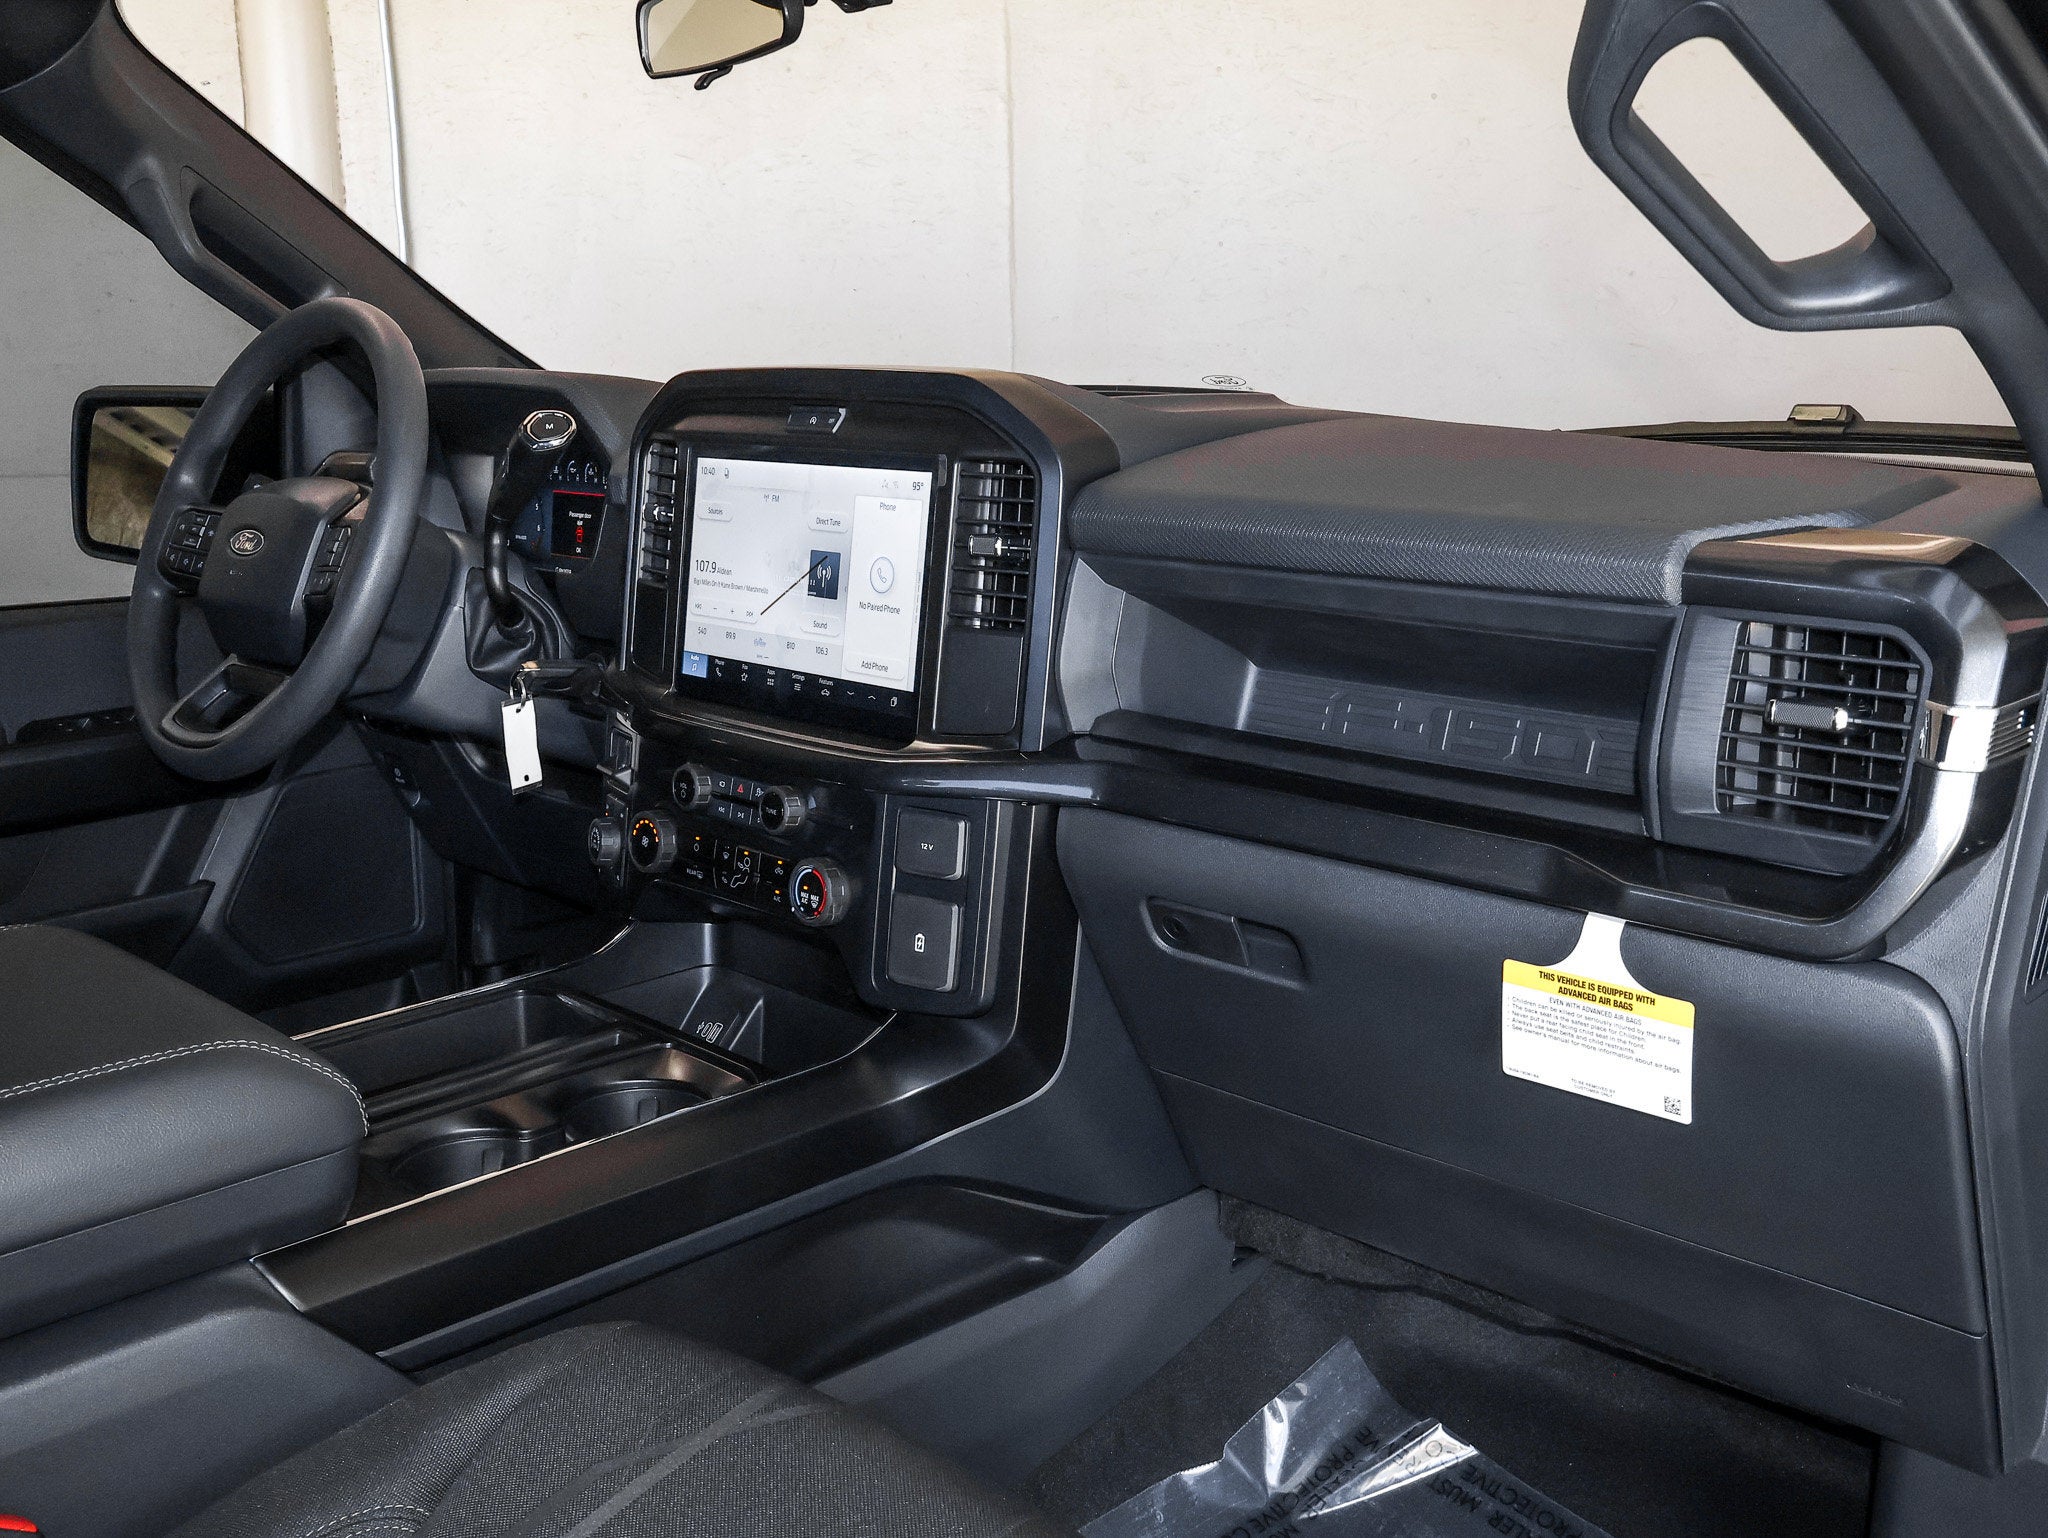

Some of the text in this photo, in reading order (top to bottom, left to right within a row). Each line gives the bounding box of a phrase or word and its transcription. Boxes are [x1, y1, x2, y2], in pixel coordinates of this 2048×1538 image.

[701, 466, 716, 476] 10:40
[771, 494, 781, 503] FM
[879, 501, 897, 512] Phone
[815, 516, 841, 527] Direct Tune
[232, 531, 261, 552] Ford
[695, 559, 717, 574] 107.9
[859, 601, 901, 615] No Paired Phone
[813, 620, 828, 630] Sound
[815, 646, 829, 656] 106.3
[860, 660, 889, 673] Add Phone
[765, 806, 778, 816] TUNE
[921, 842, 928, 851] 12
[800, 891, 809, 899] MAX
[810, 893, 820, 902] MAX
[1539, 970, 1656, 1006] THIS VEHICLE IS EQUIPPED WITH
[1558, 986, 1633, 1012] ADVANCED AIR BAGS
[1511, 995, 1537, 1007] Children
[1585, 1015, 1612, 1028] seriously
[1646, 1030, 1656, 1038] the
[1549, 996, 1642, 1026] EVEN WITH ADVANCED AIR BAGS
[1511, 1002, 1523, 1011] The
[1590, 1024, 1607, 1033] place
[1598, 1046, 1634, 1061] information
[1634, 1057, 1653, 1067] about
